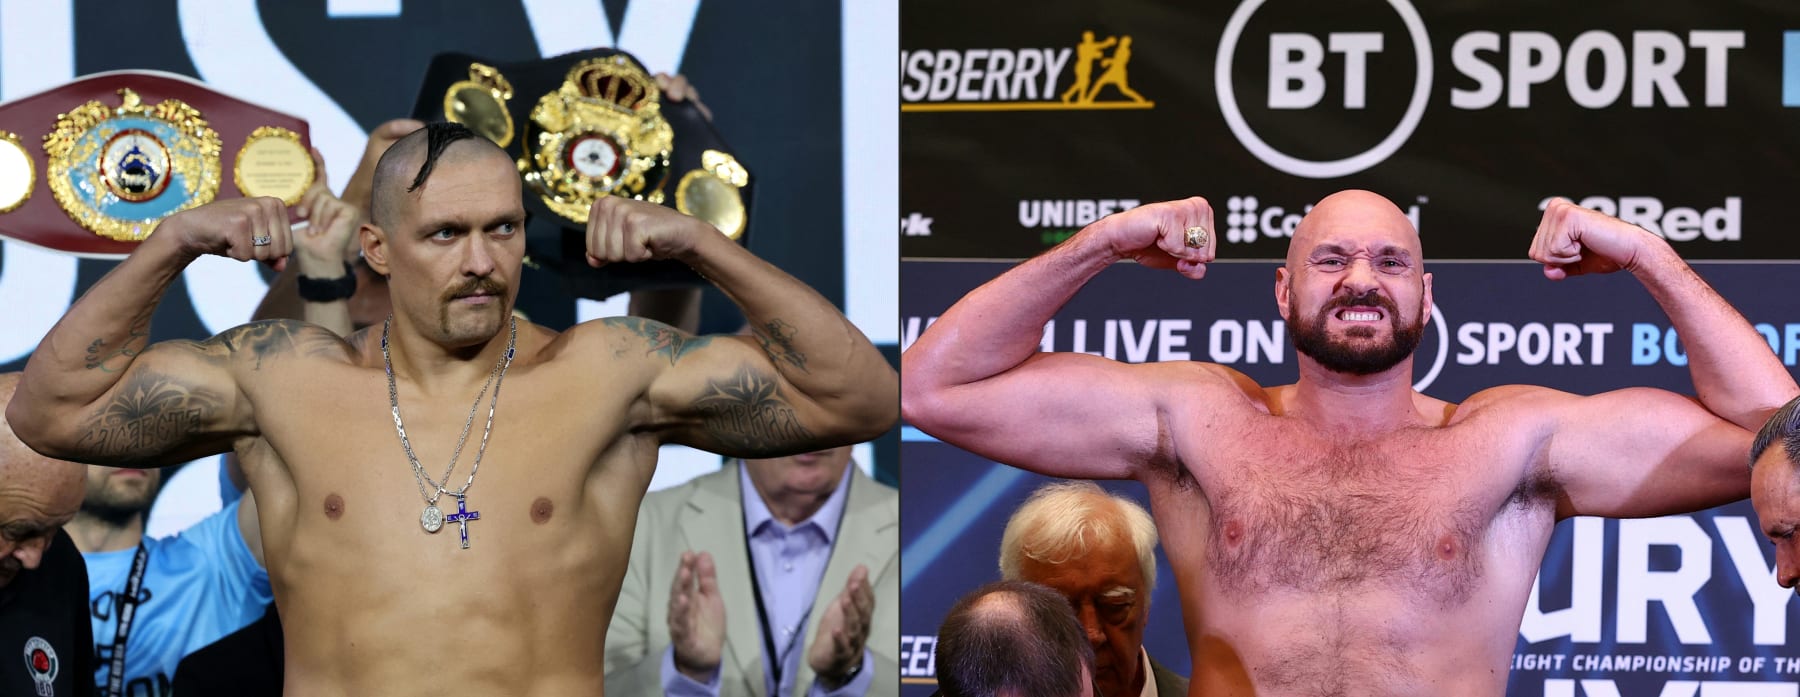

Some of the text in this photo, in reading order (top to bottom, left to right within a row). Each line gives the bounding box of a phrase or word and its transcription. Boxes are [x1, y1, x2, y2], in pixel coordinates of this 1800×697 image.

[1268, 32, 1384, 109] BT
[1451, 30, 1745, 109] SPORT
[1538, 196, 1741, 241] Red
[1073, 319, 1191, 363] LIVE
[1209, 319, 1284, 363] ON
[1456, 323, 1613, 366] SPORT
[1519, 516, 1799, 644] URY
[1572, 655, 1731, 673] CHAMPIONSHIP
[1738, 657, 1766, 673] OF
